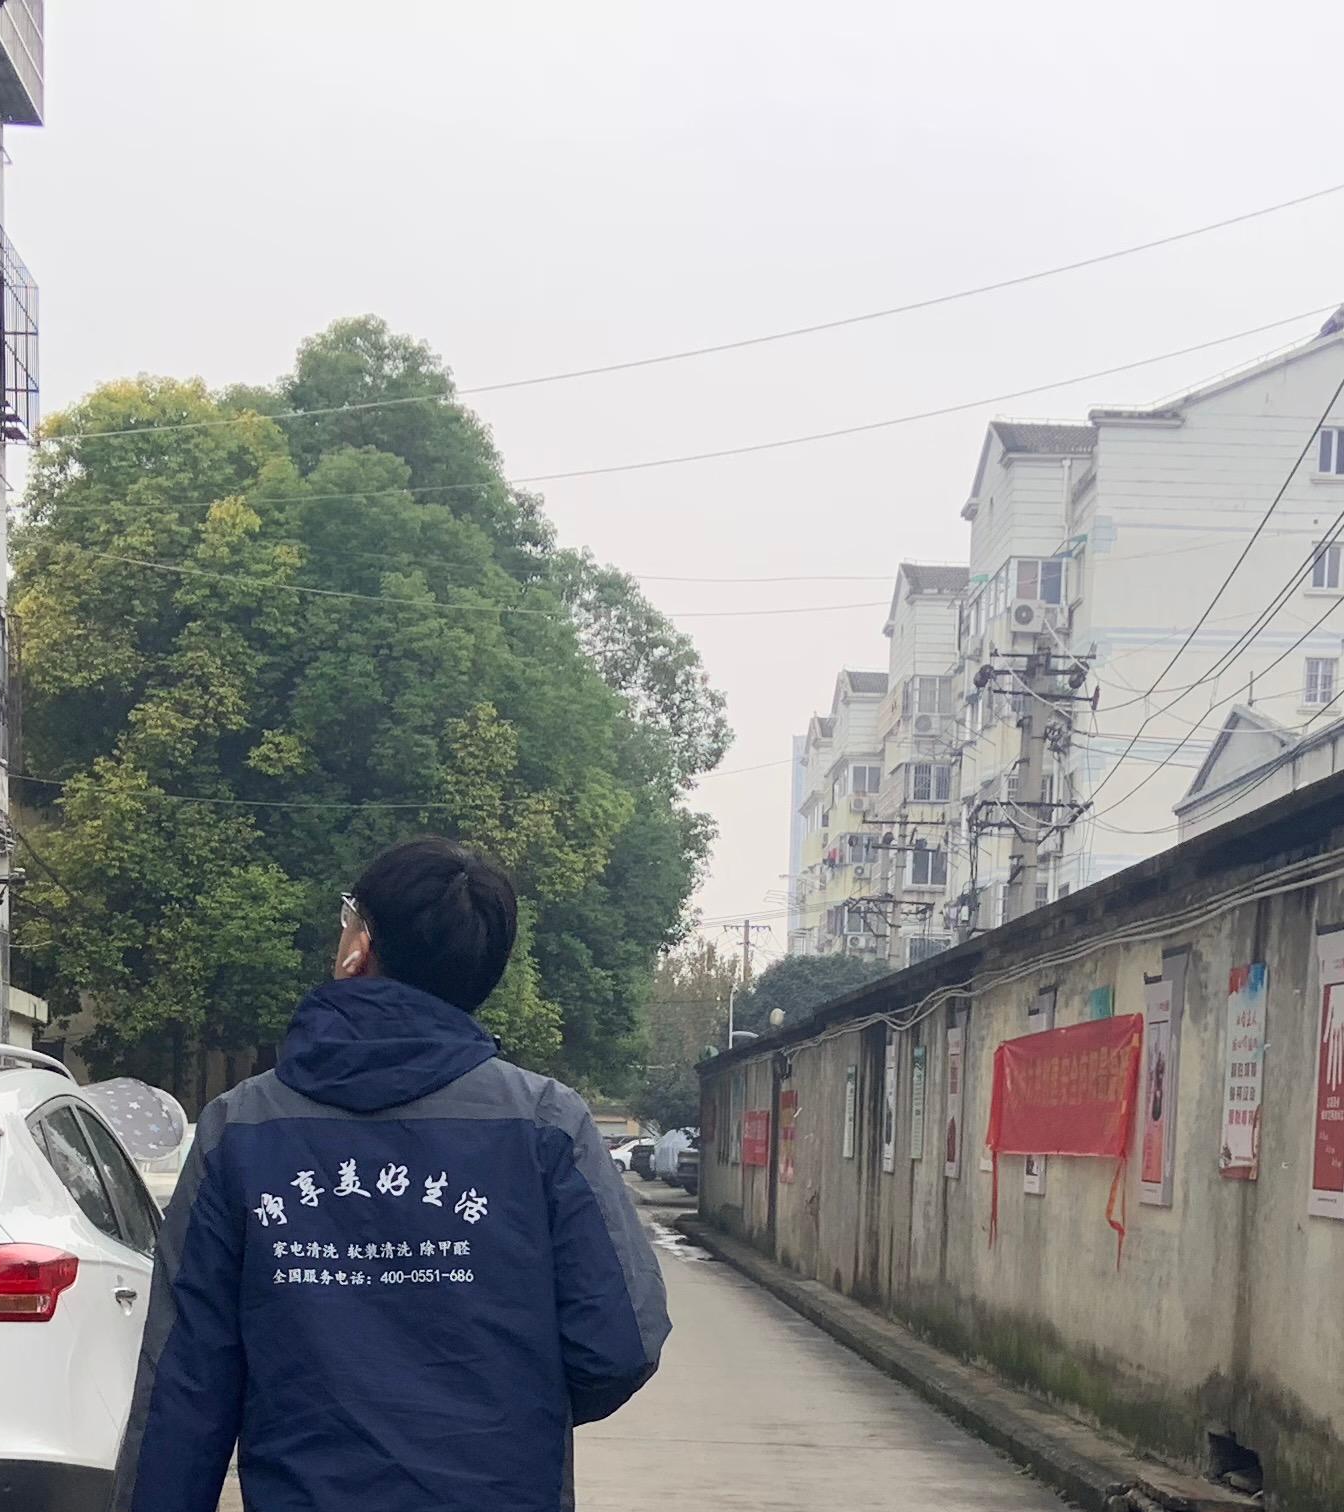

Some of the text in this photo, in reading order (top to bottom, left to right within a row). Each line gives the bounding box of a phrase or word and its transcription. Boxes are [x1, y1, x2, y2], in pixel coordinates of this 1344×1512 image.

[272, 1240, 471, 1260] 家电清洗 软装清洗 除甲醛
